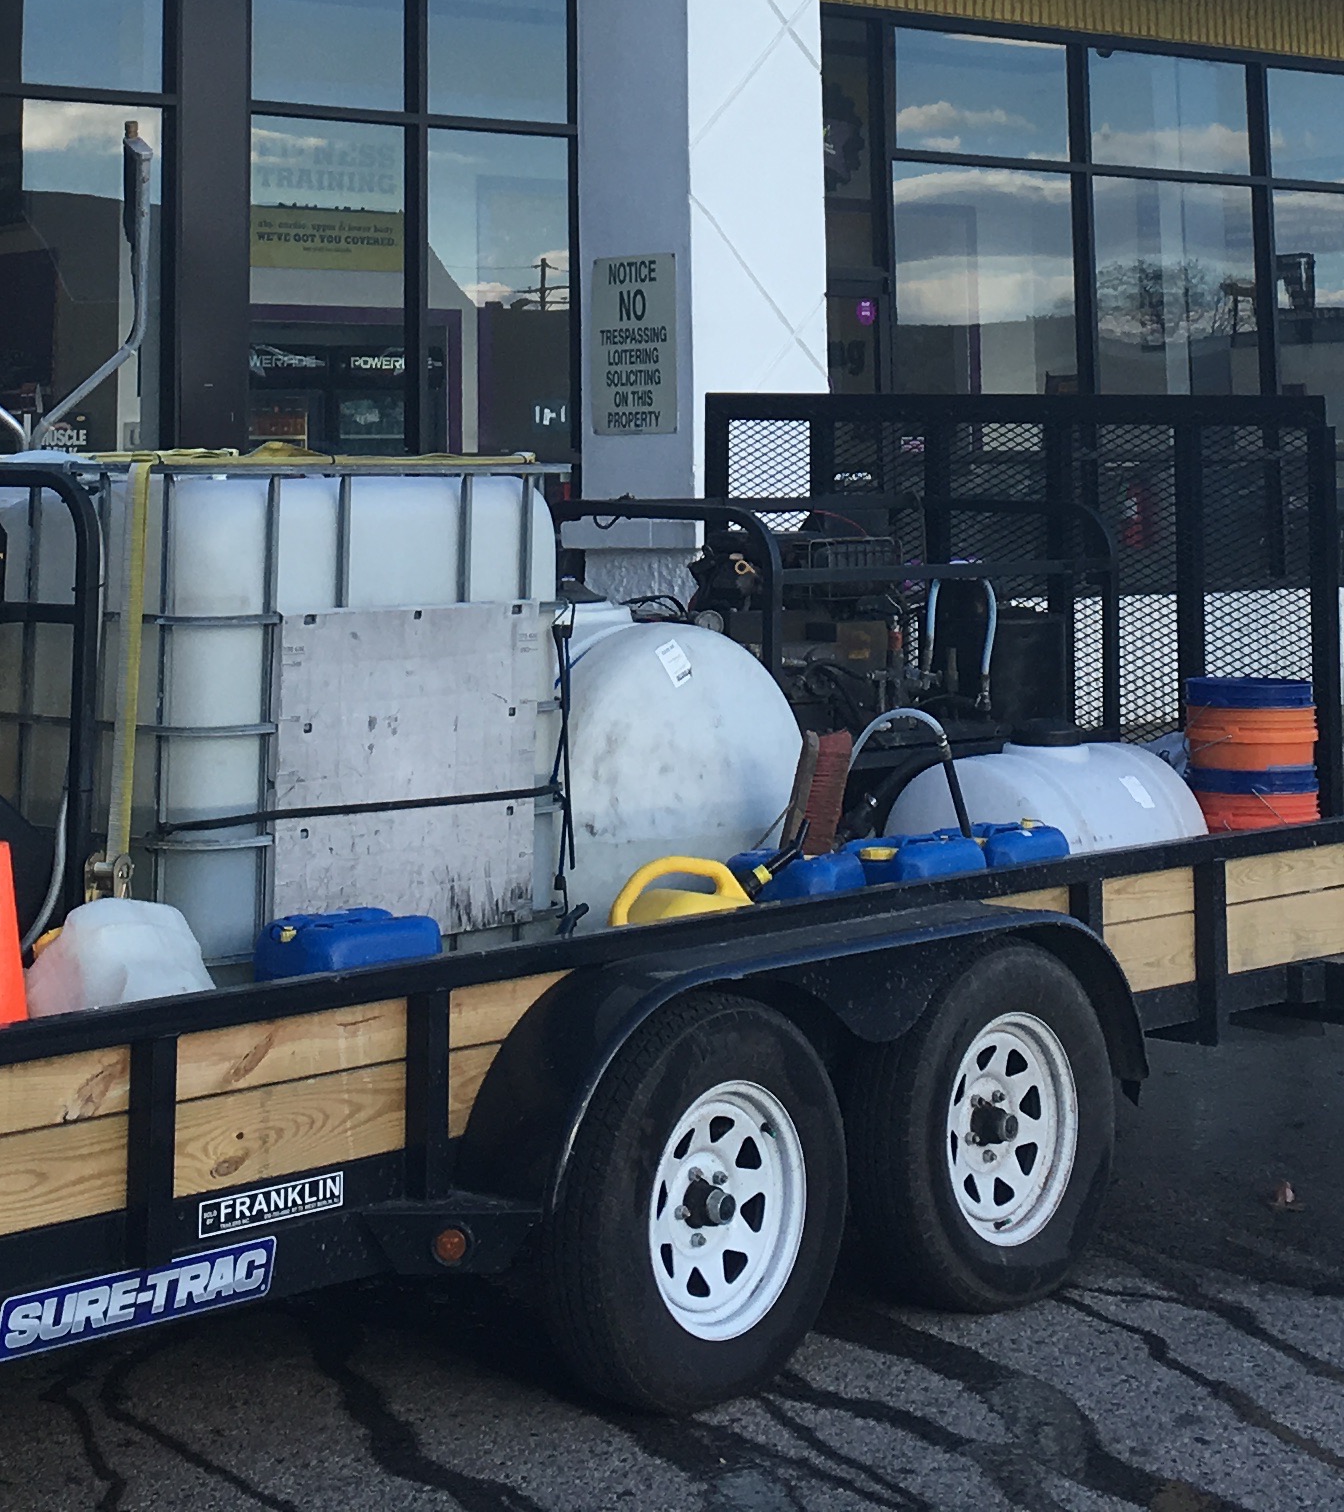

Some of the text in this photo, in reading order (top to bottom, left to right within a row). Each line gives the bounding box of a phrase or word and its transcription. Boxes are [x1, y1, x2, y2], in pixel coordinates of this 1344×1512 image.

[256, 166, 398, 195] TRAINING
[293, 233, 317, 244] GOT
[319, 234, 342, 244] YOU
[608, 259, 657, 285] NOTICE
[618, 288, 647, 322] NO
[600, 325, 667, 346] TRESPASSING
[350, 355, 405, 370] POWER
[607, 347, 659, 366] LOITERING
[606, 368, 661, 388] SOLICITING
[614, 389, 653, 408] ON THIS
[607, 410, 661, 429] PROPERTY
[220, 1176, 340, 1223] FRANKLIN
[4, 1247, 268, 1350] SURE-TRAC
